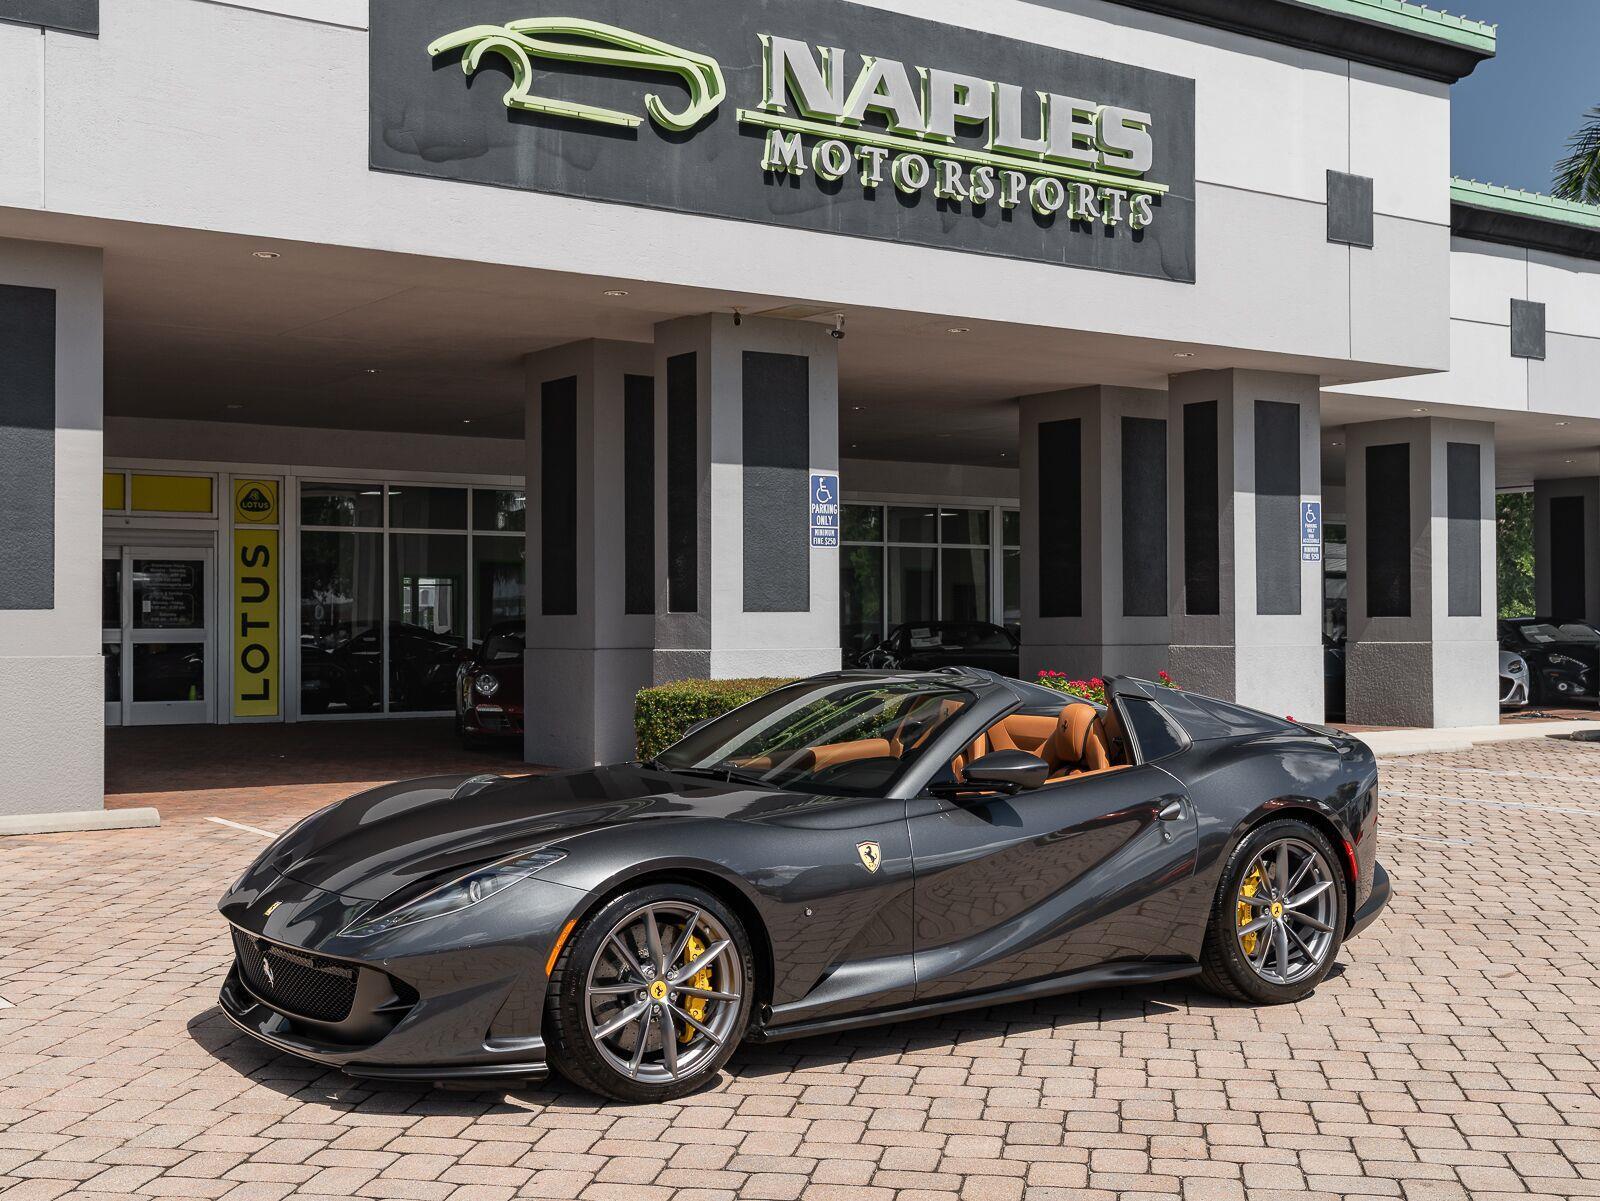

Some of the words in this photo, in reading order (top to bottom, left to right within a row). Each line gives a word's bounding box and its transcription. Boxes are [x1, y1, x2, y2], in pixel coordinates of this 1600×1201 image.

[757, 33, 1153, 176] NAPLES
[763, 129, 1154, 229] MOTORSPORTS
[242, 501, 269, 509] LOTUS
[812, 504, 837, 514] PARKING
[817, 516, 832, 525] ONLY
[824, 537, 836, 545] $250
[241, 544, 271, 701] LOTUS
